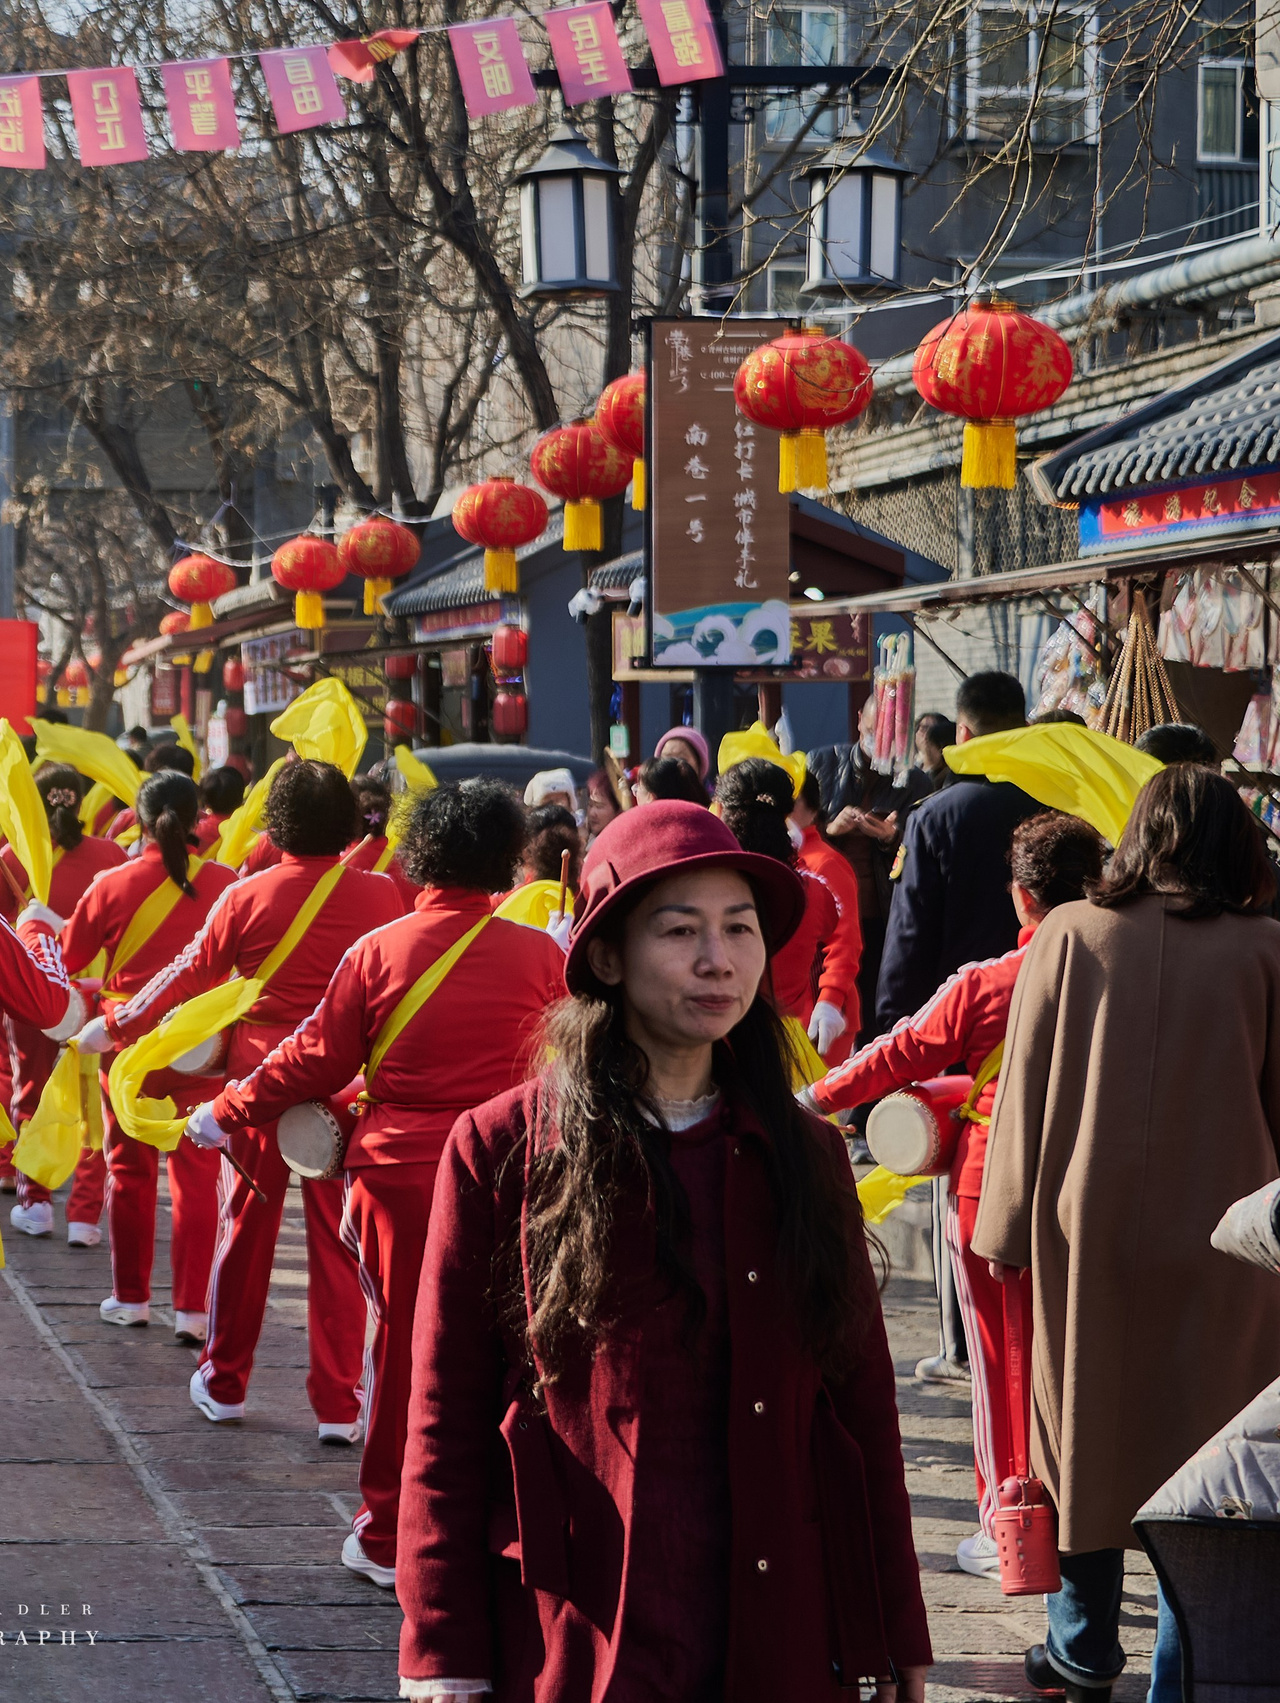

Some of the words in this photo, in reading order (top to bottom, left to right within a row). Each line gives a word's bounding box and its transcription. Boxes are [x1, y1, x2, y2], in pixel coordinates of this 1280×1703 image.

[709, 371, 737, 380] 400-7
[733, 487, 760, 590] 城市伴手礼
